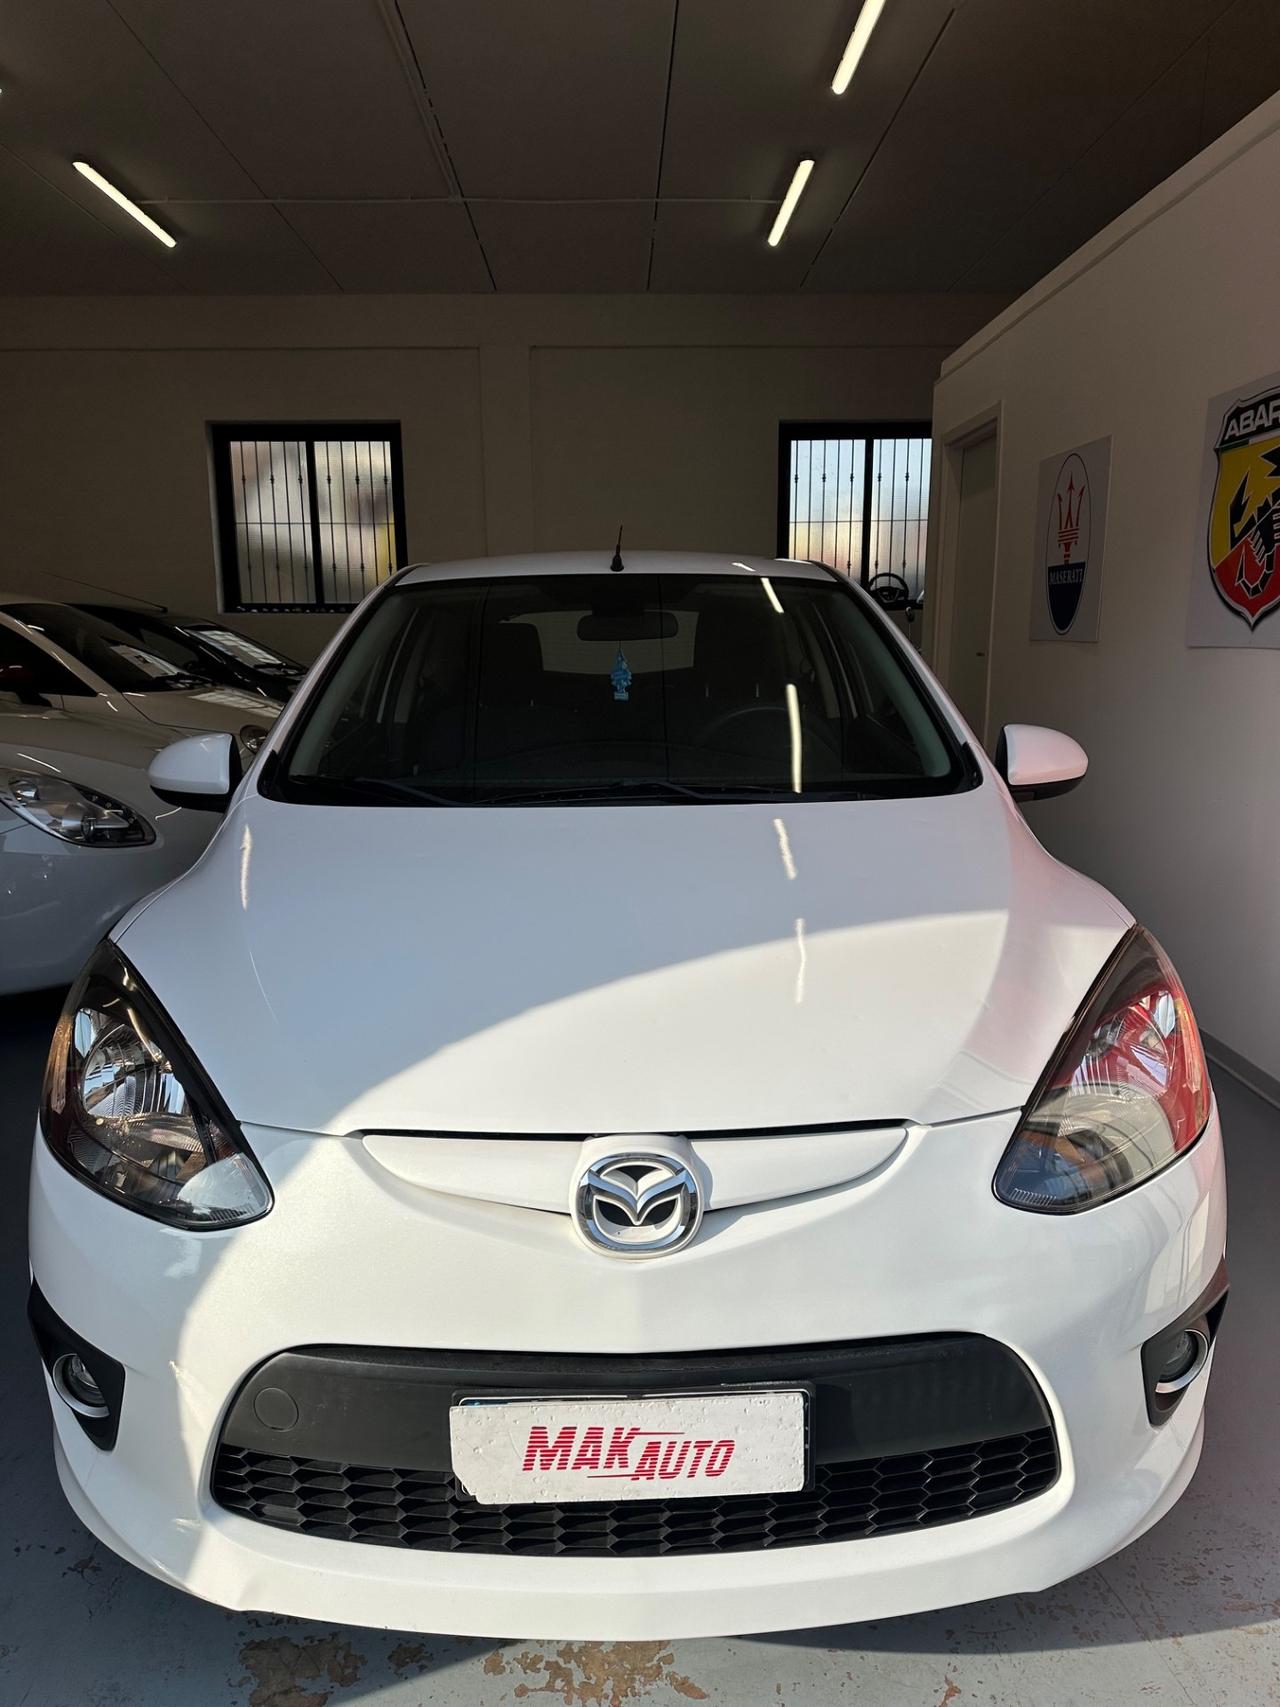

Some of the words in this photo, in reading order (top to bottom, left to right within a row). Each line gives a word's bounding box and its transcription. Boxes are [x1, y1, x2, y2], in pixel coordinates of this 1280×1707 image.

[1049, 568, 1083, 585] MASERATI
[522, 1426, 641, 1471] MAK
[630, 1440, 736, 1481] AUTO
